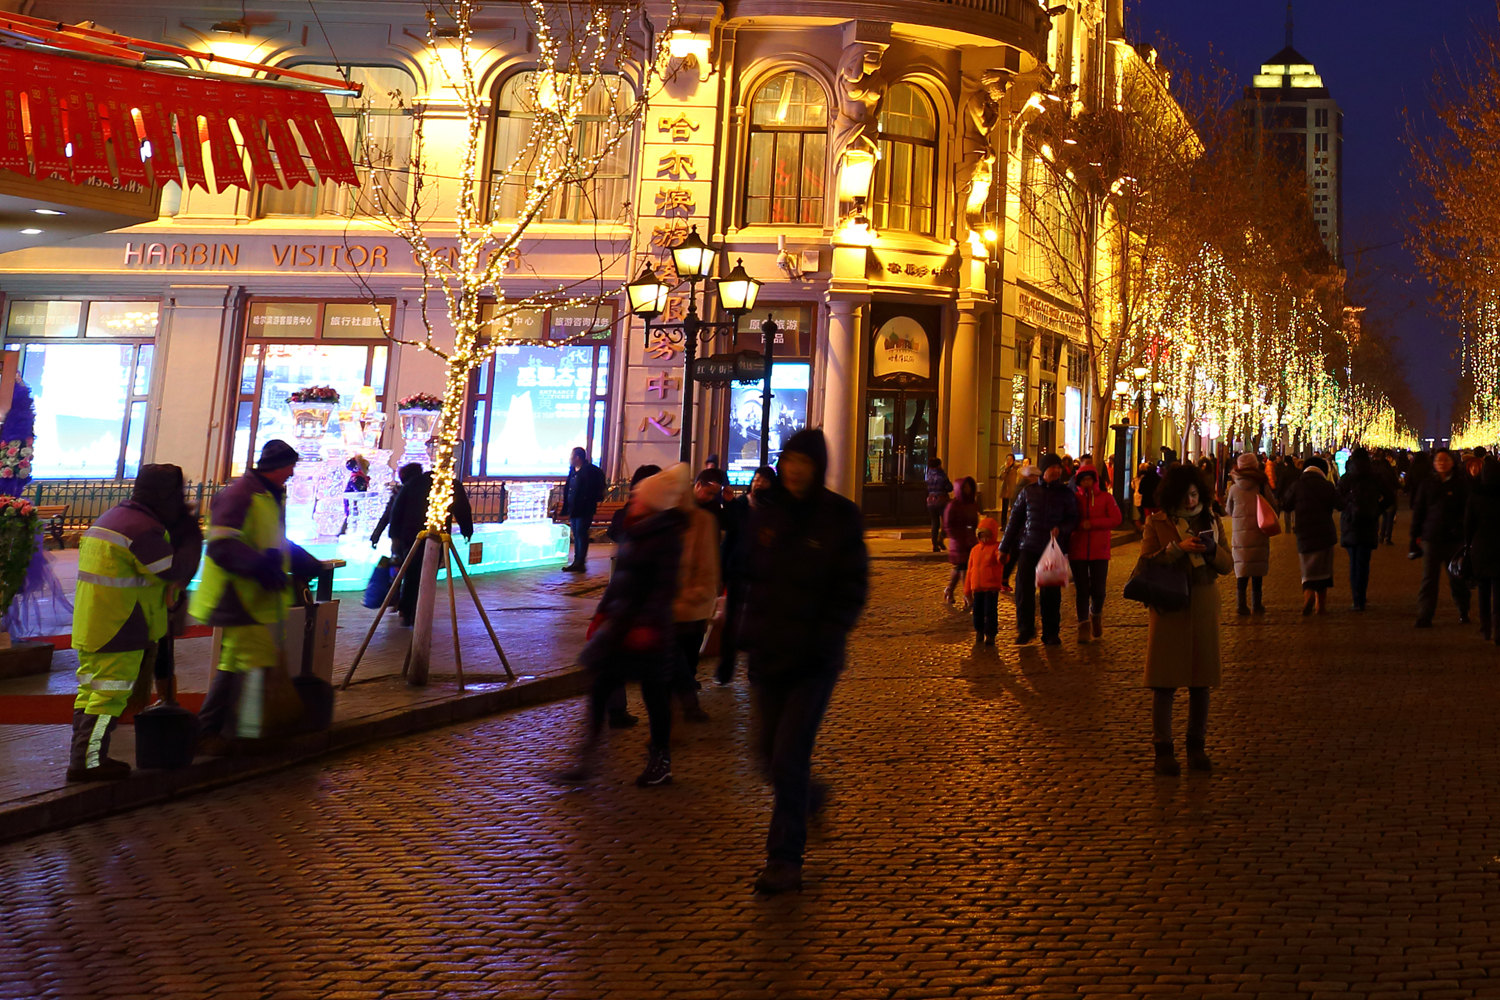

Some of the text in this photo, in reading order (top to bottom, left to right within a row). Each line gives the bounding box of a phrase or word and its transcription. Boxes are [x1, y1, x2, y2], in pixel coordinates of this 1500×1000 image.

[124, 242, 240, 266] HARBIN
[272, 244, 389, 267] VISITOR
[253, 315, 313, 326] 哈尔滨游客服务中心
[330, 316, 382, 327] 旅行社超市
[749, 319, 799, 331] 原旅游
